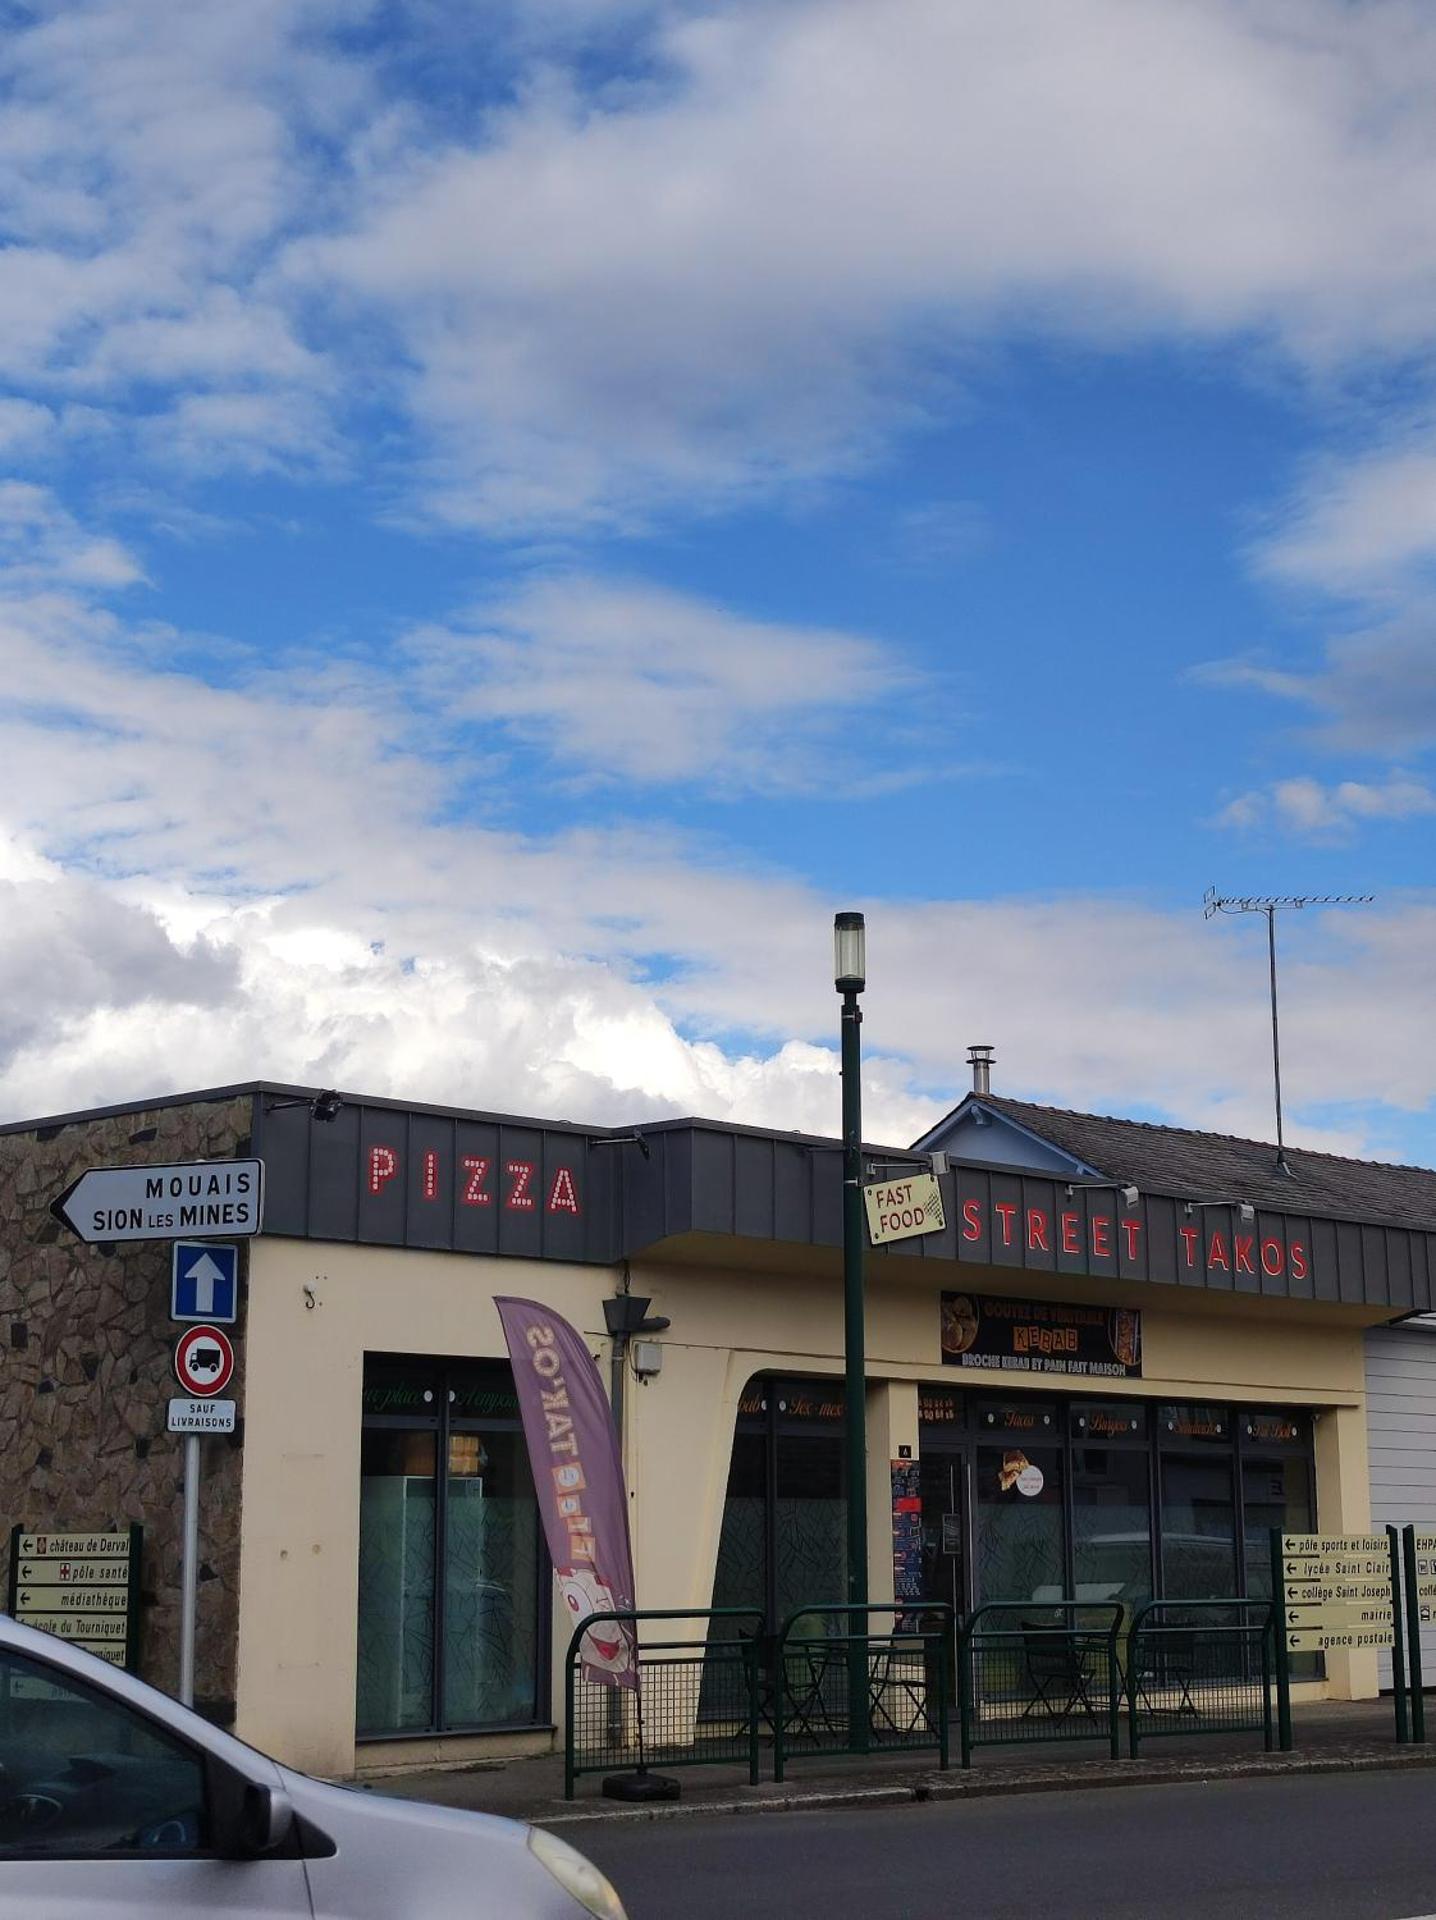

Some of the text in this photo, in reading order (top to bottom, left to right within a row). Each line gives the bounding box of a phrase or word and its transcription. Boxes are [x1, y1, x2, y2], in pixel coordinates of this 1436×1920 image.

[146, 1173, 250, 1198] MOUAIS
[370, 1146, 578, 1213] PIZZA
[876, 1184, 912, 1208] FAST
[93, 1203, 249, 1231] SION LES MINES
[880, 1208, 924, 1233] FOOD
[963, 1200, 1309, 1279] STREET TAKOS
[1014, 1327, 1078, 1352] KEBAB
[1031, 1358, 1042, 1371] ET
[1044, 1359, 1067, 1373] PAIN
[1068, 1360, 1088, 1374] FAIT
[1089, 1362, 1126, 1377] MAISON
[190, 1404, 216, 1414] SAUF
[171, 1417, 232, 1428] LIVRAISONS
[50, 1538, 130, 1553] château de Derval
[1299, 1539, 1389, 1553] pôle sports et loisirs
[72, 1565, 128, 1581] pôle santé
[1304, 1561, 1390, 1576] lycée Saint Clair
[61, 1592, 127, 1609] médiathèque
[1302, 1585, 1391, 1600] collège Saint Joseph
[1361, 1609, 1392, 1620] mairie
[61, 1619, 72, 1632] du
[77, 1619, 125, 1636] Tourniquet
[1318, 1633, 1393, 1649] agence postale
